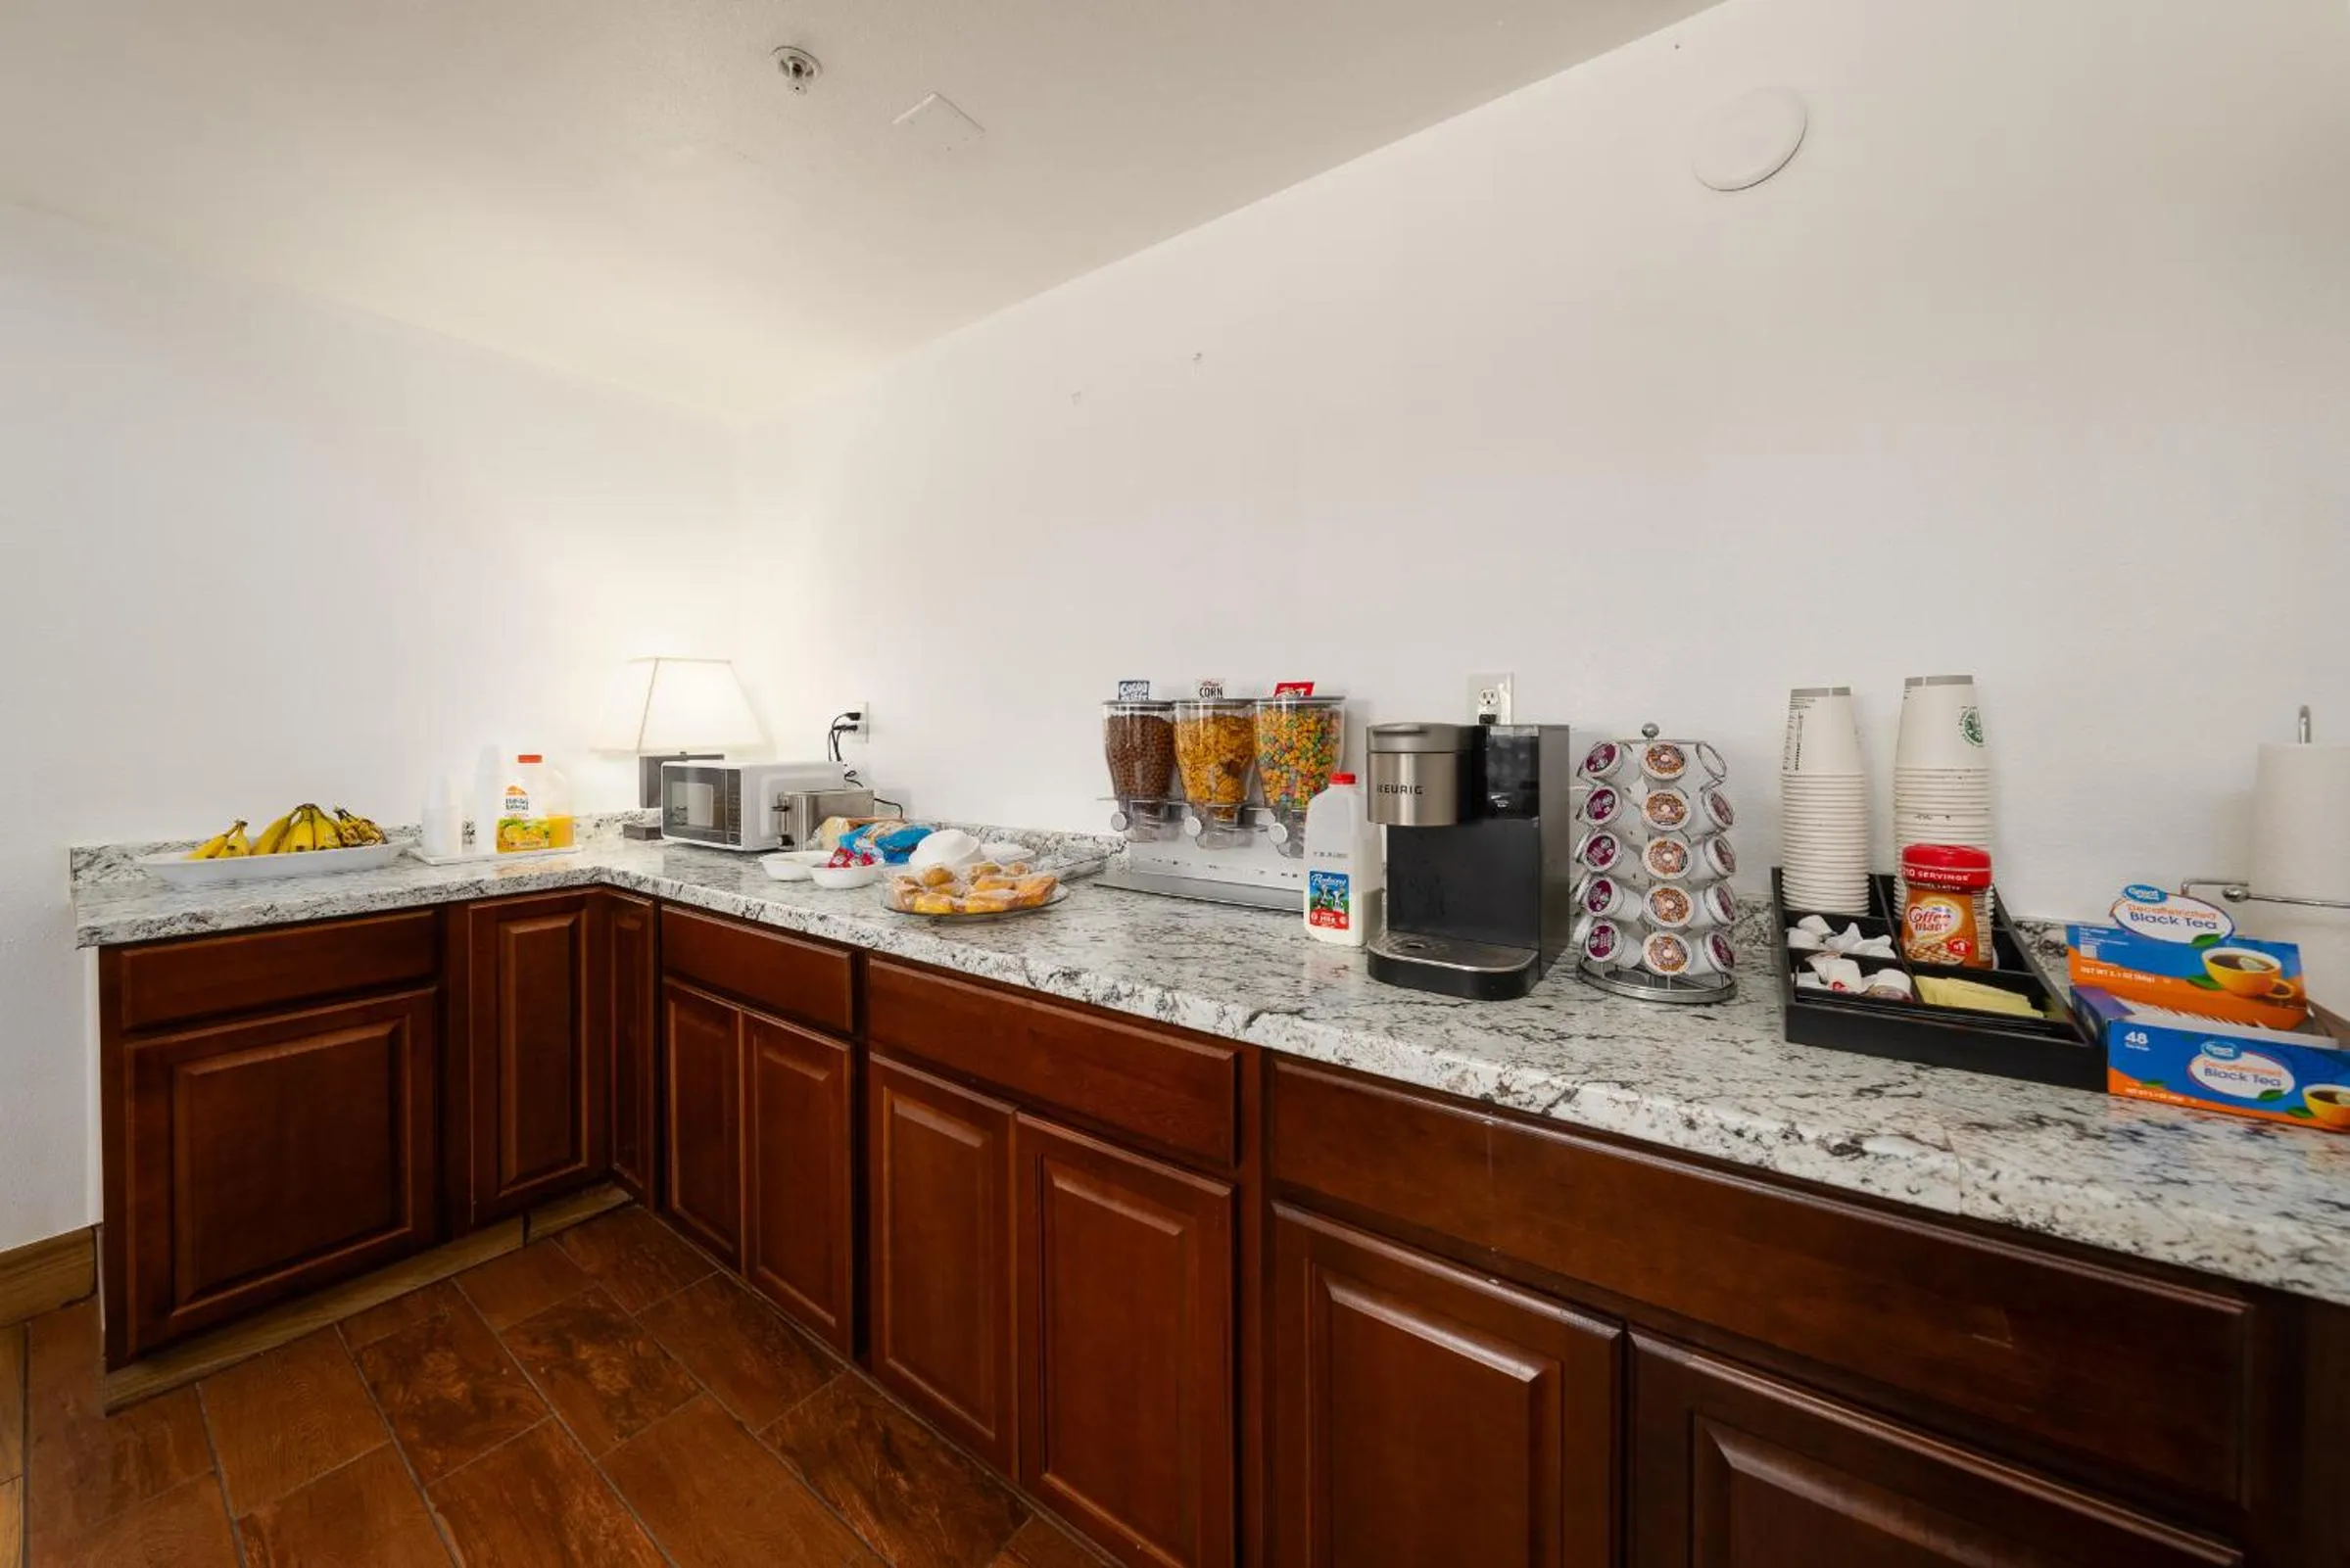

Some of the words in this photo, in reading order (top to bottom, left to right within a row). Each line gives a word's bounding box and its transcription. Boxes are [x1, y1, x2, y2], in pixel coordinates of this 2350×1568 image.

[1199, 687, 1223, 698] CORN
[1917, 871, 1968, 881] SERVINGS
[2130, 912, 2180, 926] Black
[2185, 917, 2218, 929] Tea
[2124, 1030, 2149, 1045] 48
[2204, 1068, 2248, 1082] Black
[2253, 1074, 2281, 1087] Tea
